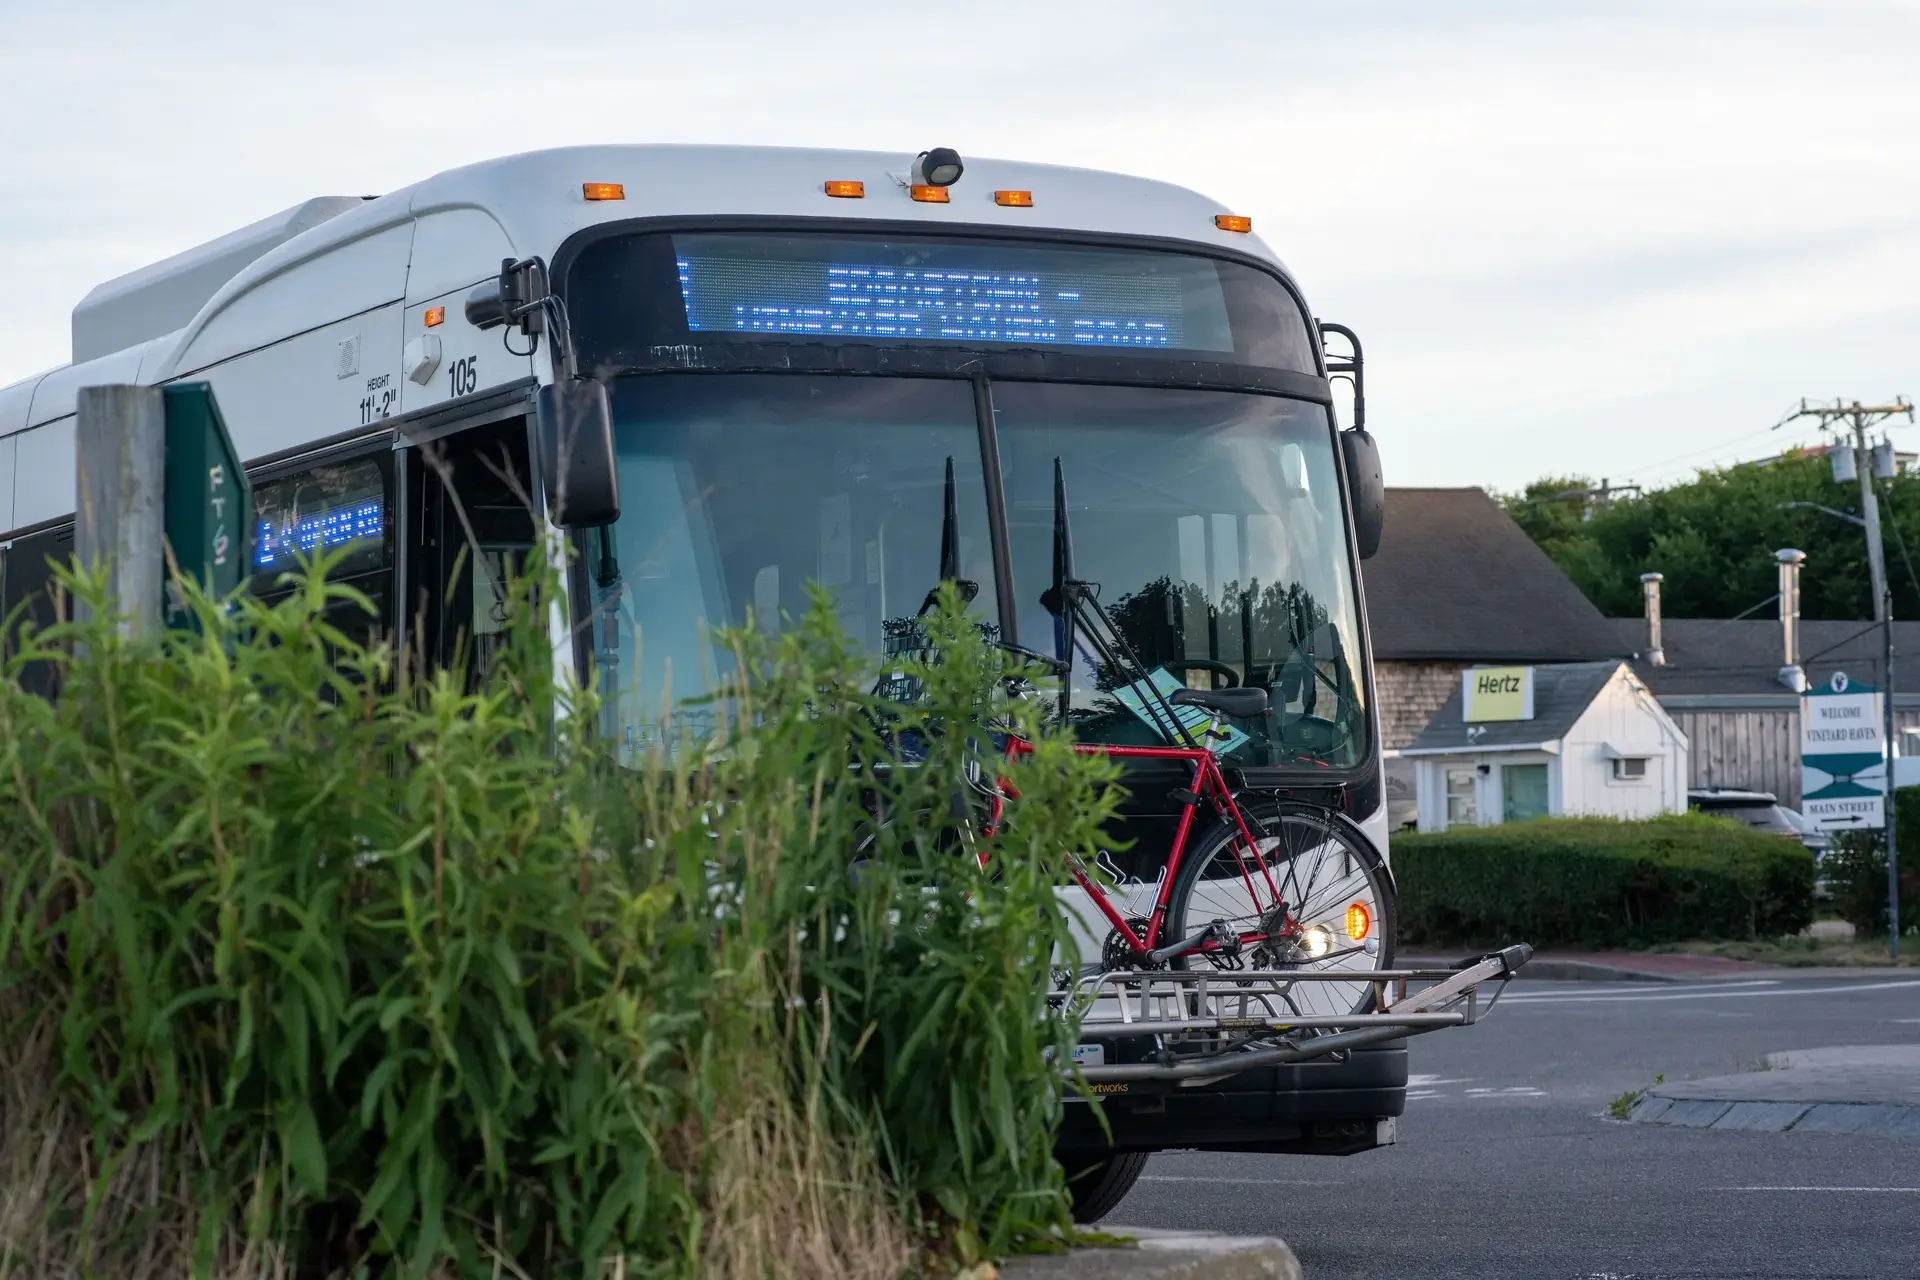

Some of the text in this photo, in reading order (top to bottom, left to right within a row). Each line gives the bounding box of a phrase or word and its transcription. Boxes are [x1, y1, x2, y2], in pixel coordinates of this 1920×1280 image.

[367, 374, 390, 391] HEIGHT
[448, 355, 477, 398] 105
[1478, 674, 1521, 694] Hertz
[1820, 707, 1861, 720] WELCOME
[1807, 727, 1877, 743] VINEYARD HAVEN
[1809, 801, 1876, 815] MAIN STREET
[1089, 1083, 1129, 1093] ortworks
